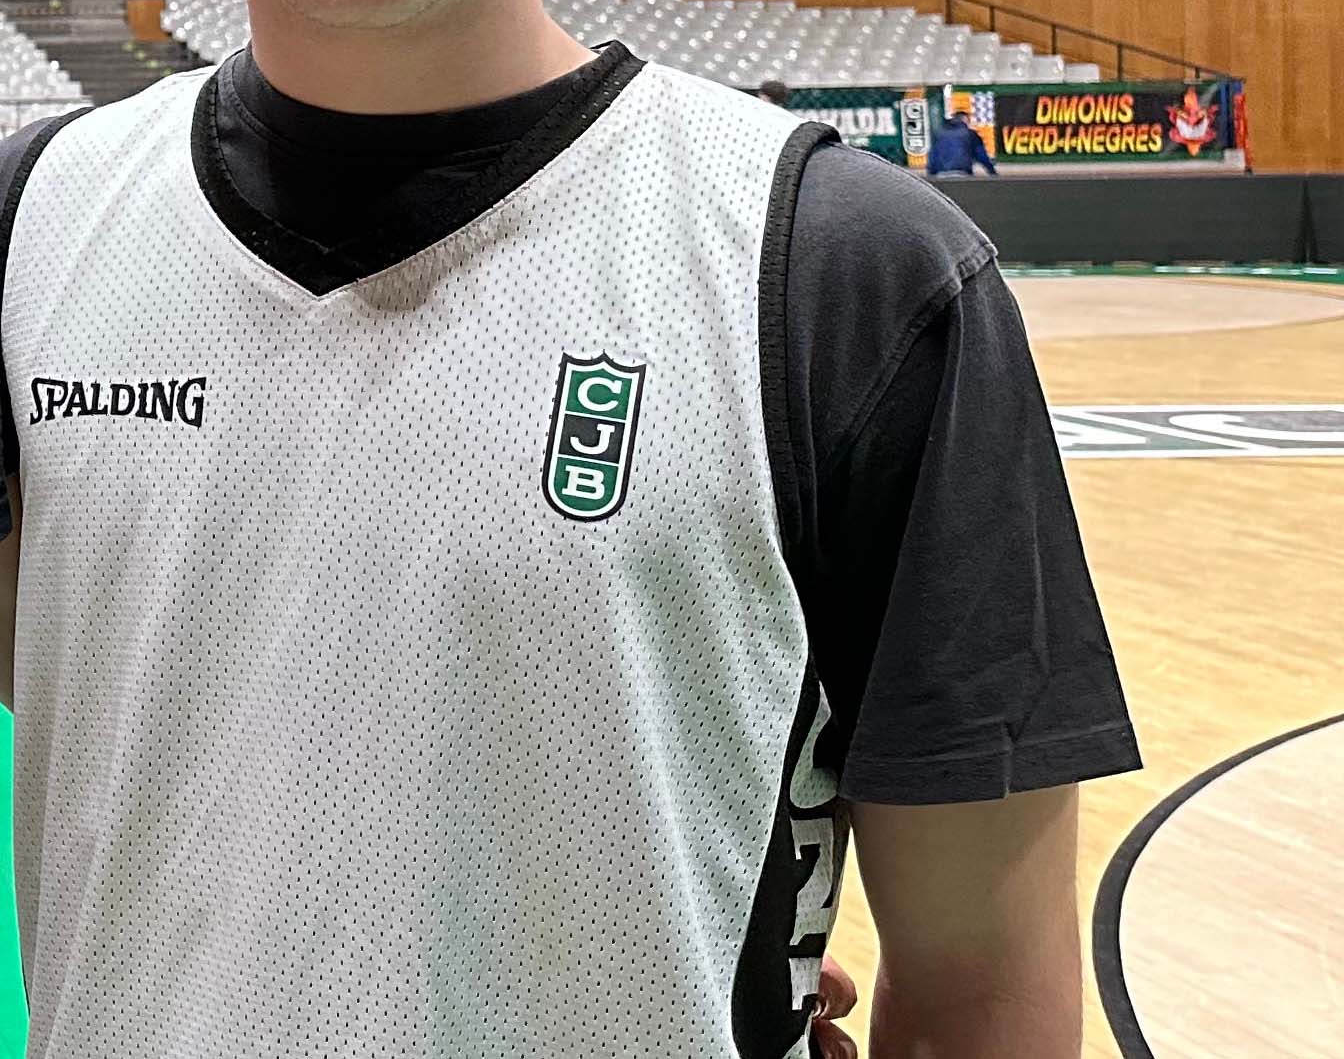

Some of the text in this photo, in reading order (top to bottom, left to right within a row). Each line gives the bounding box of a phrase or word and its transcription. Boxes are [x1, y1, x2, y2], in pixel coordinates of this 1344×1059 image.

[1035, 93, 1135, 125] DIMONIS
[1002, 123, 1163, 155] VERD-I-NEGRES
[29, 375, 208, 428] SPALDING
